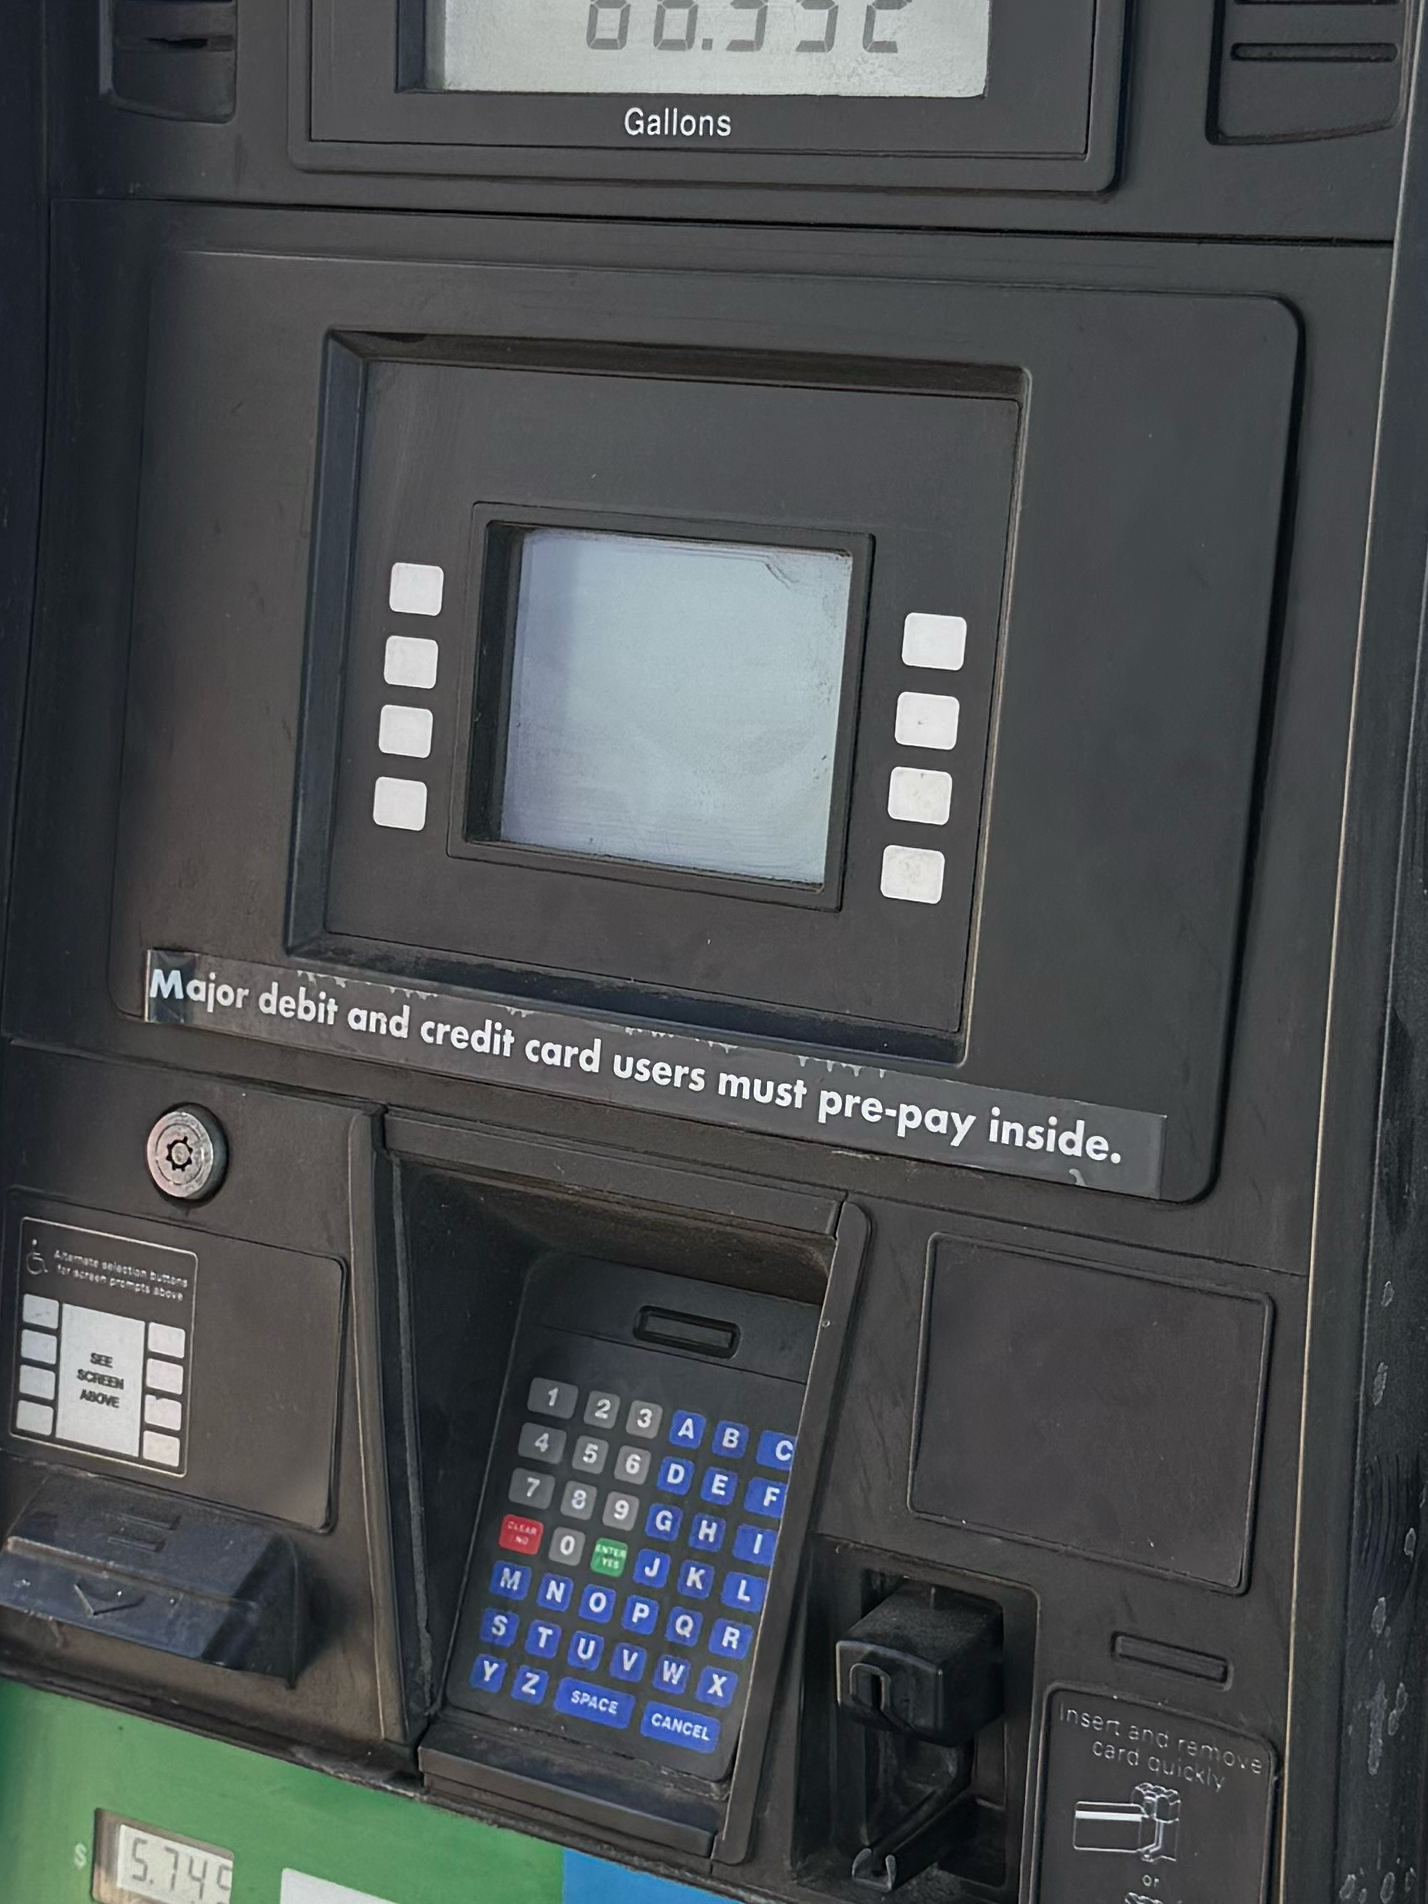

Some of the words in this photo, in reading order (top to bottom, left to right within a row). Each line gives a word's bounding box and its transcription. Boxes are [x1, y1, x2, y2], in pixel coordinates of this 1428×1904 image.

[623, 107, 732, 137] Gallons
[149, 968, 250, 1013] Major
[258, 981, 339, 1027] debit
[347, 1005, 410, 1040] and
[420, 1019, 515, 1058] credit
[525, 1038, 601, 1074] card
[612, 1050, 706, 1092] users
[717, 1076, 807, 1110] must
[817, 1089, 976, 1147] pre-pay
[988, 1106, 1122, 1165] inside.
